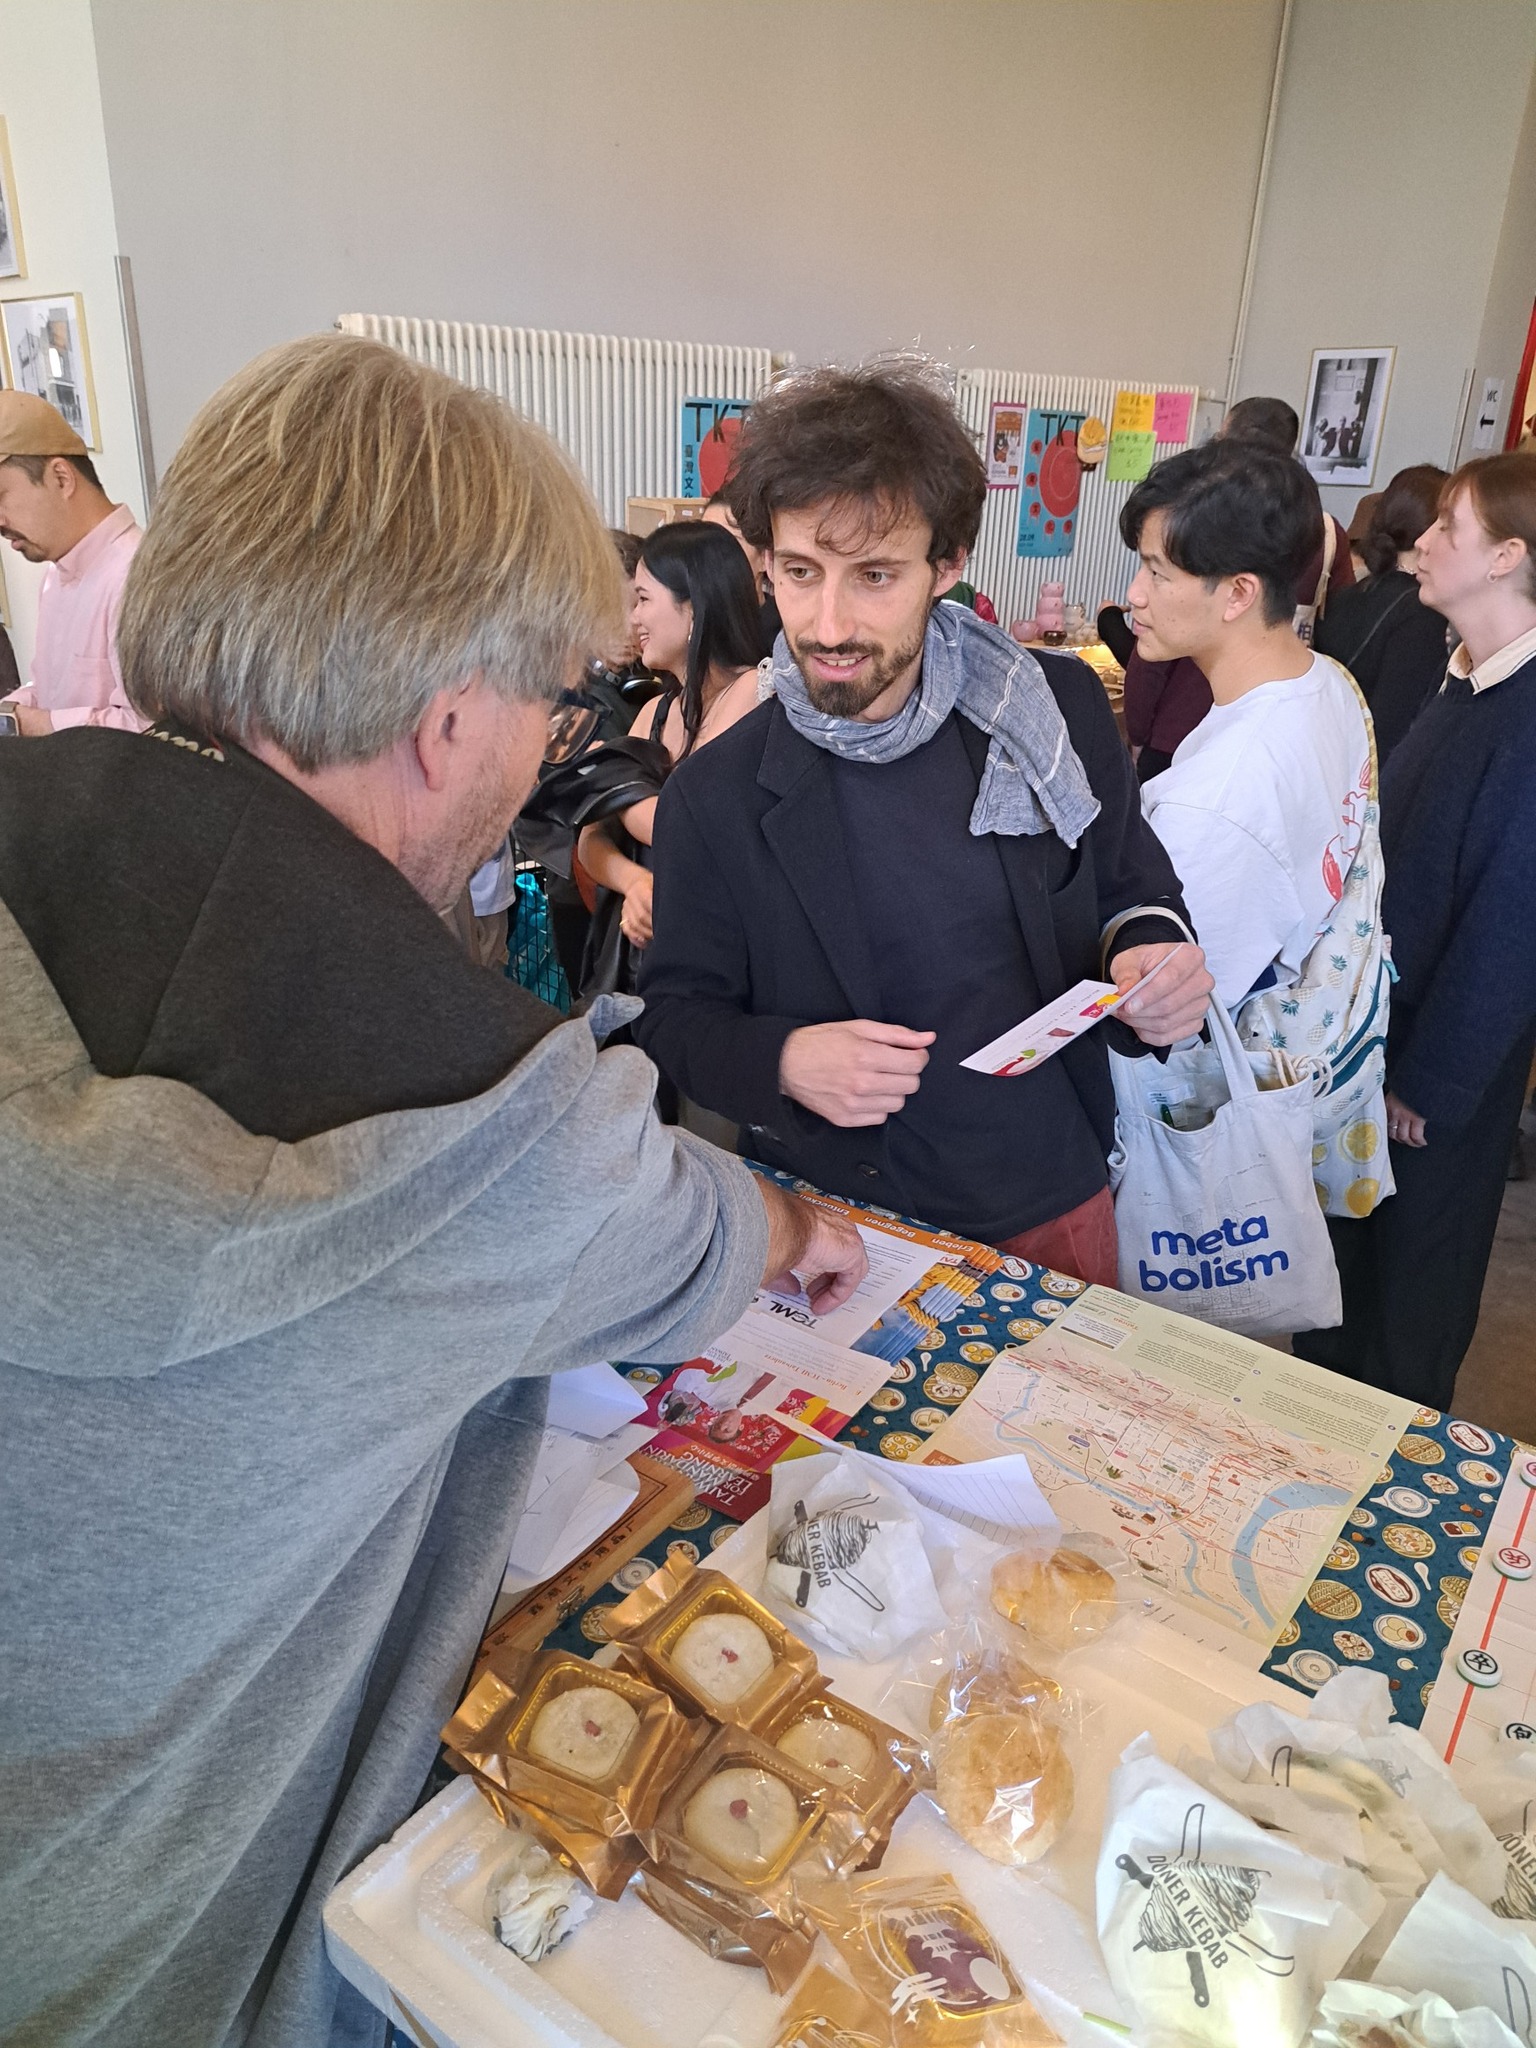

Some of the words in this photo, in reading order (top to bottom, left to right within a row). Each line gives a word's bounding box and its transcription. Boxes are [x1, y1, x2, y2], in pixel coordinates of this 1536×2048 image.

[1040, 413, 1086, 446] TKT
[864, 1216, 916, 1238] Begegnen
[931, 1237, 975, 1253] Erleben
[1151, 1215, 1270, 1256] meta
[1138, 1250, 1290, 1292] bolism
[770, 1300, 818, 1329] TCML
[643, 1444, 723, 1487] MANDARIN
[681, 1451, 753, 1492] LEARNING
[722, 1480, 749, 1496] FOR
[810, 1543, 832, 1589] KEBAB
[1183, 1905, 1229, 1969] KEBAB
